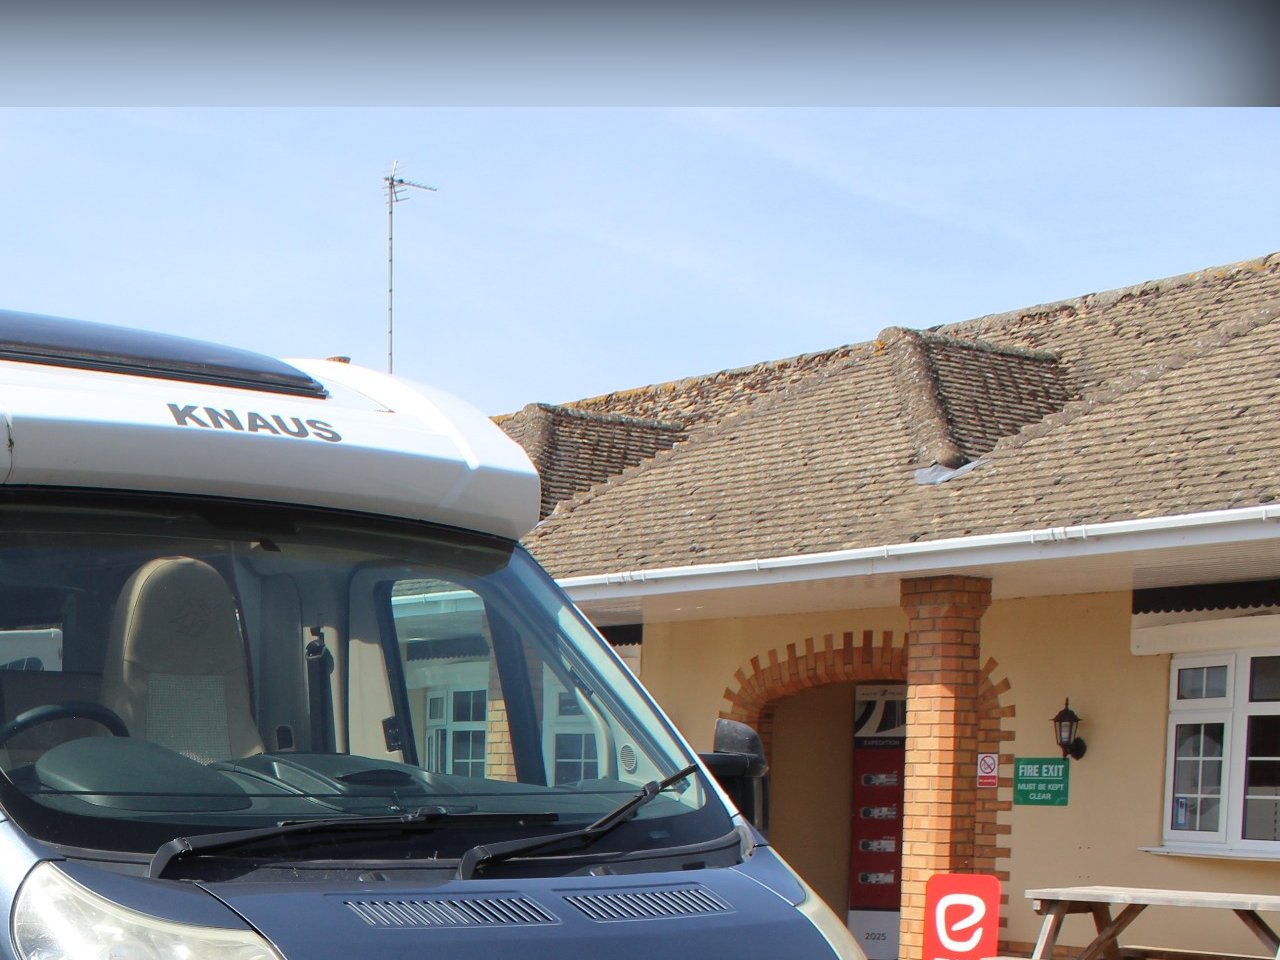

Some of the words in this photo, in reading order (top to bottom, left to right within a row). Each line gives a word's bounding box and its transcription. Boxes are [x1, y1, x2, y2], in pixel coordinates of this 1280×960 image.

[166, 403, 342, 443] KNAUS
[1019, 764, 1039, 777] FIRE
[1042, 764, 1064, 777] EXIT
[864, 932, 887, 941] 2025
